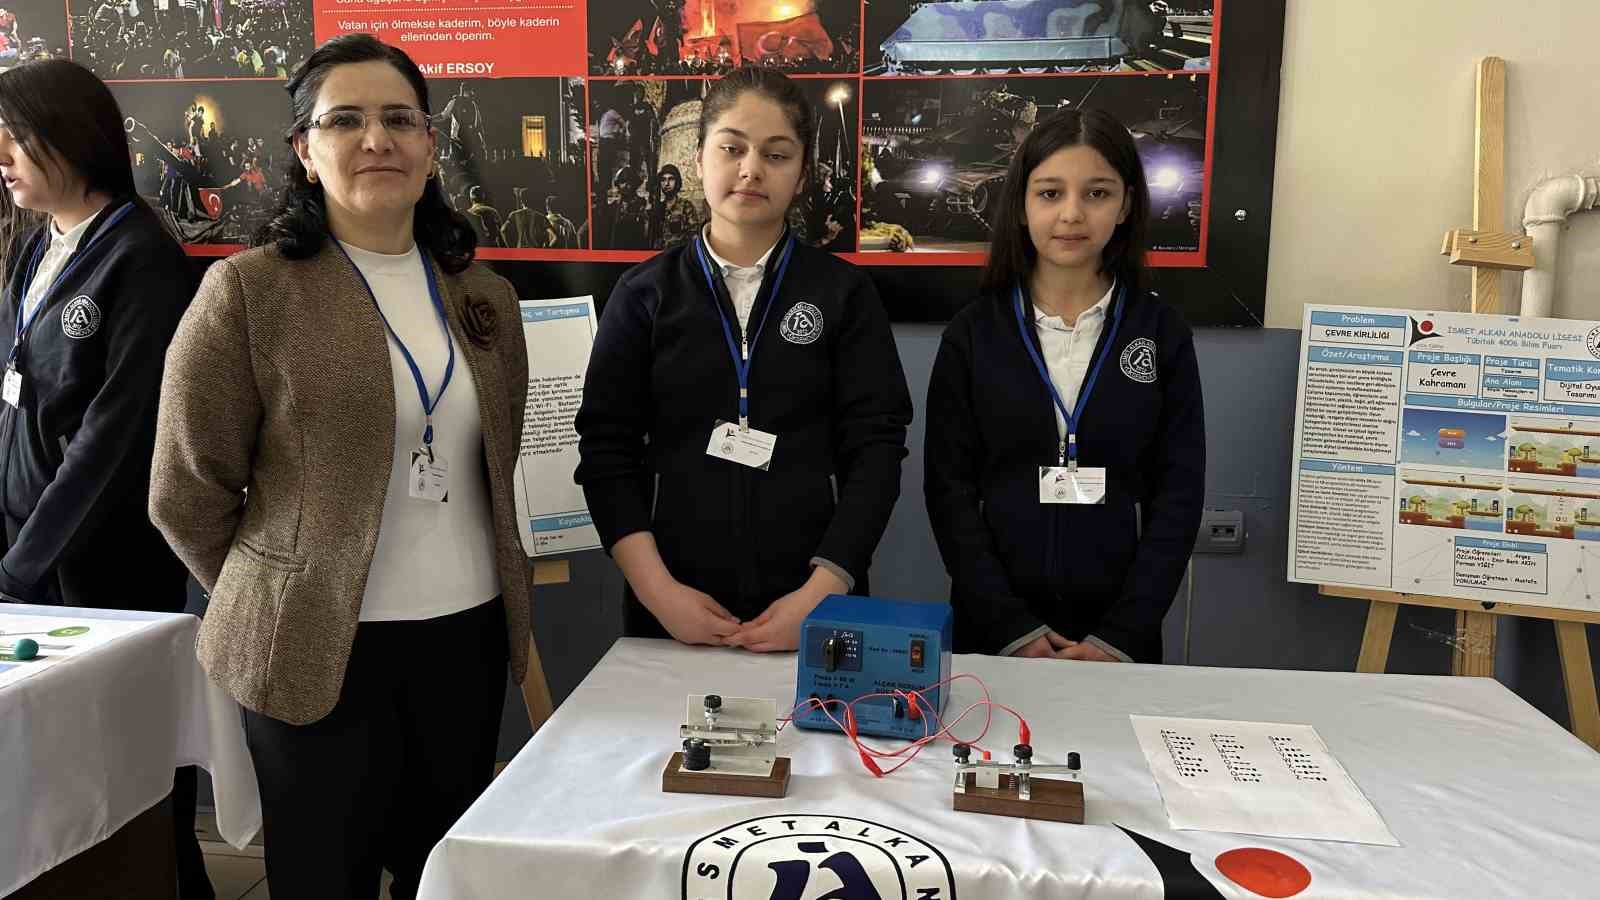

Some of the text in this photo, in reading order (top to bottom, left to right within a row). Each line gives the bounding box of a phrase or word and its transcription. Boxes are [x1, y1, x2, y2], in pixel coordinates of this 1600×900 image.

[338, 17, 560, 32] Vatan için ölmekse kaderim, böyle kaderin
[400, 31, 495, 42] ellerinden öperim.
[447, 63, 494, 74] ERSOY
[1341, 314, 1375, 324] Problem
[1325, 329, 1352, 338] ÇEVRE
[1417, 352, 1440, 362] Proje
[1430, 368, 1457, 378] Çevre
[1548, 363, 1584, 373] Tematik
[1419, 378, 1467, 389] Kahramanı
[696, 820, 798, 880] SMET
